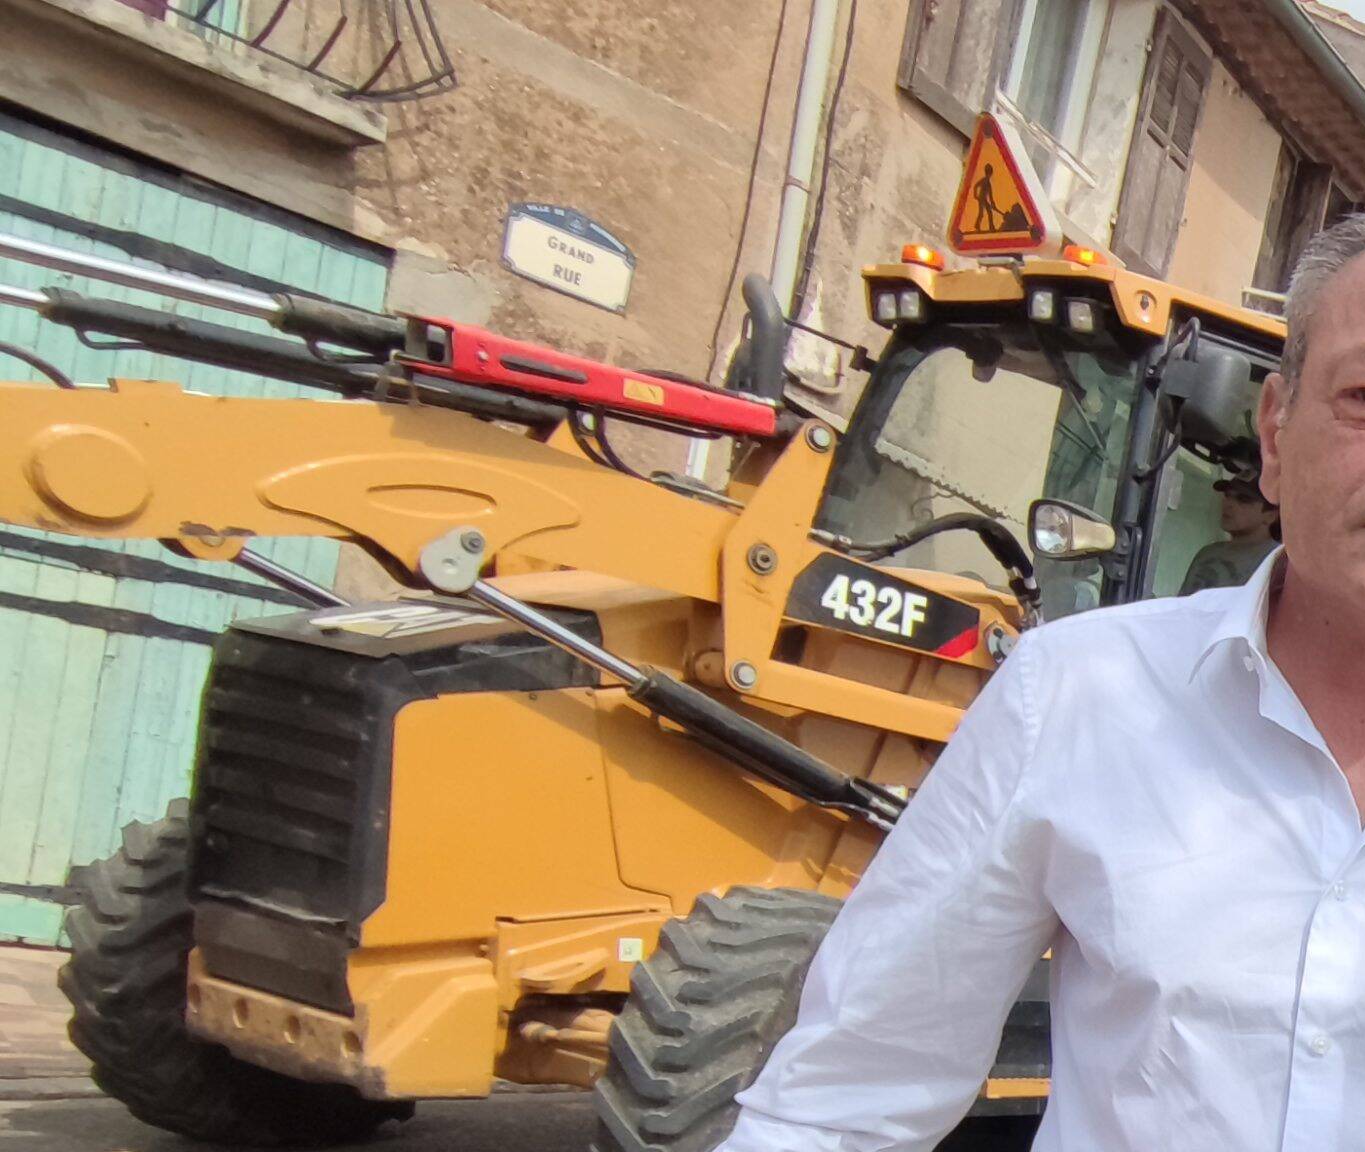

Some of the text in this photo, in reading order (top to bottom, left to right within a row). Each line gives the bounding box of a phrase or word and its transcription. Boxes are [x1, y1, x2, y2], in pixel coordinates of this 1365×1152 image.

[547, 235, 595, 264] GRAND
[552, 263, 582, 286] RUE
[821, 574, 928, 638] 432F
